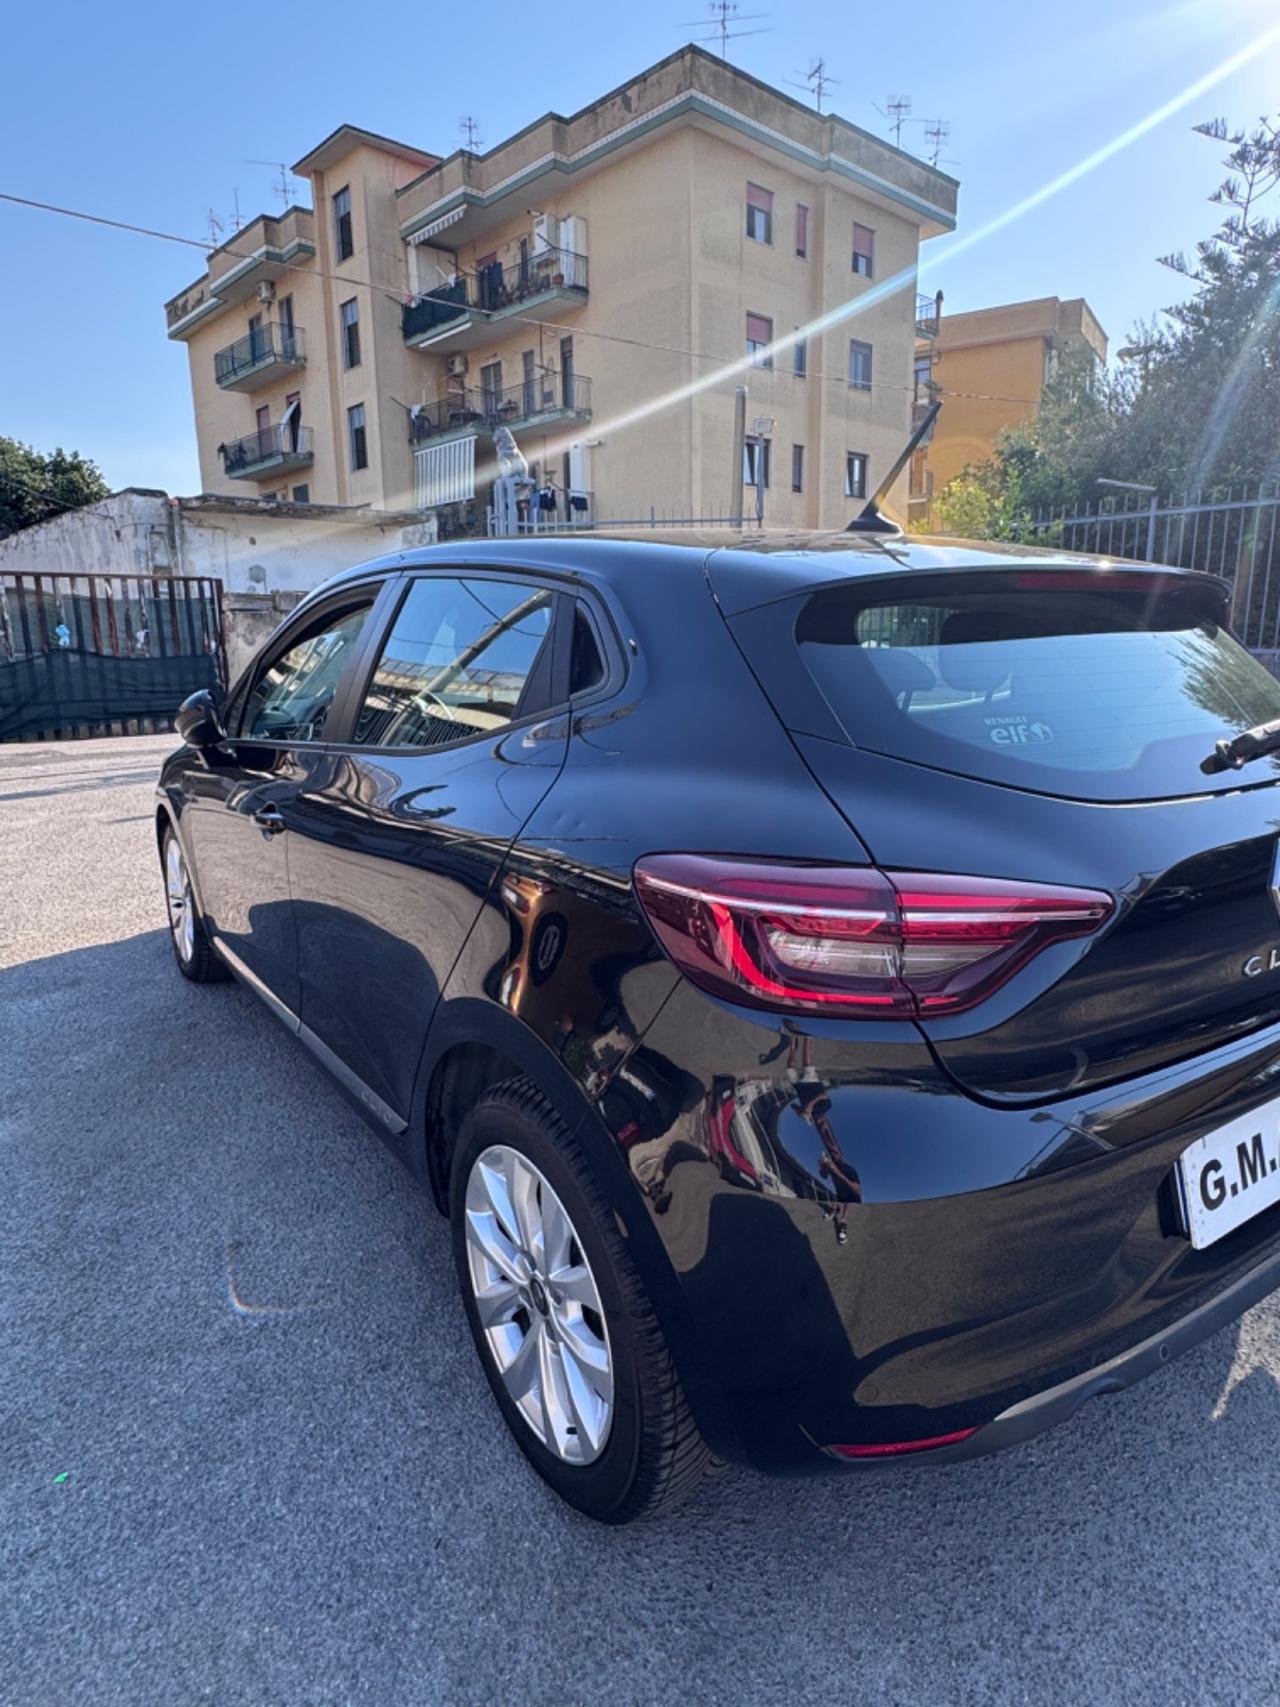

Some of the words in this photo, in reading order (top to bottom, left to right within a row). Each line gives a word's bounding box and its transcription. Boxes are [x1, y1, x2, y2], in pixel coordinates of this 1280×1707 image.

[983, 715, 1027, 726] RENAULT
[990, 724, 1027, 744] elf
[1200, 1132, 1280, 1211] G.M.
